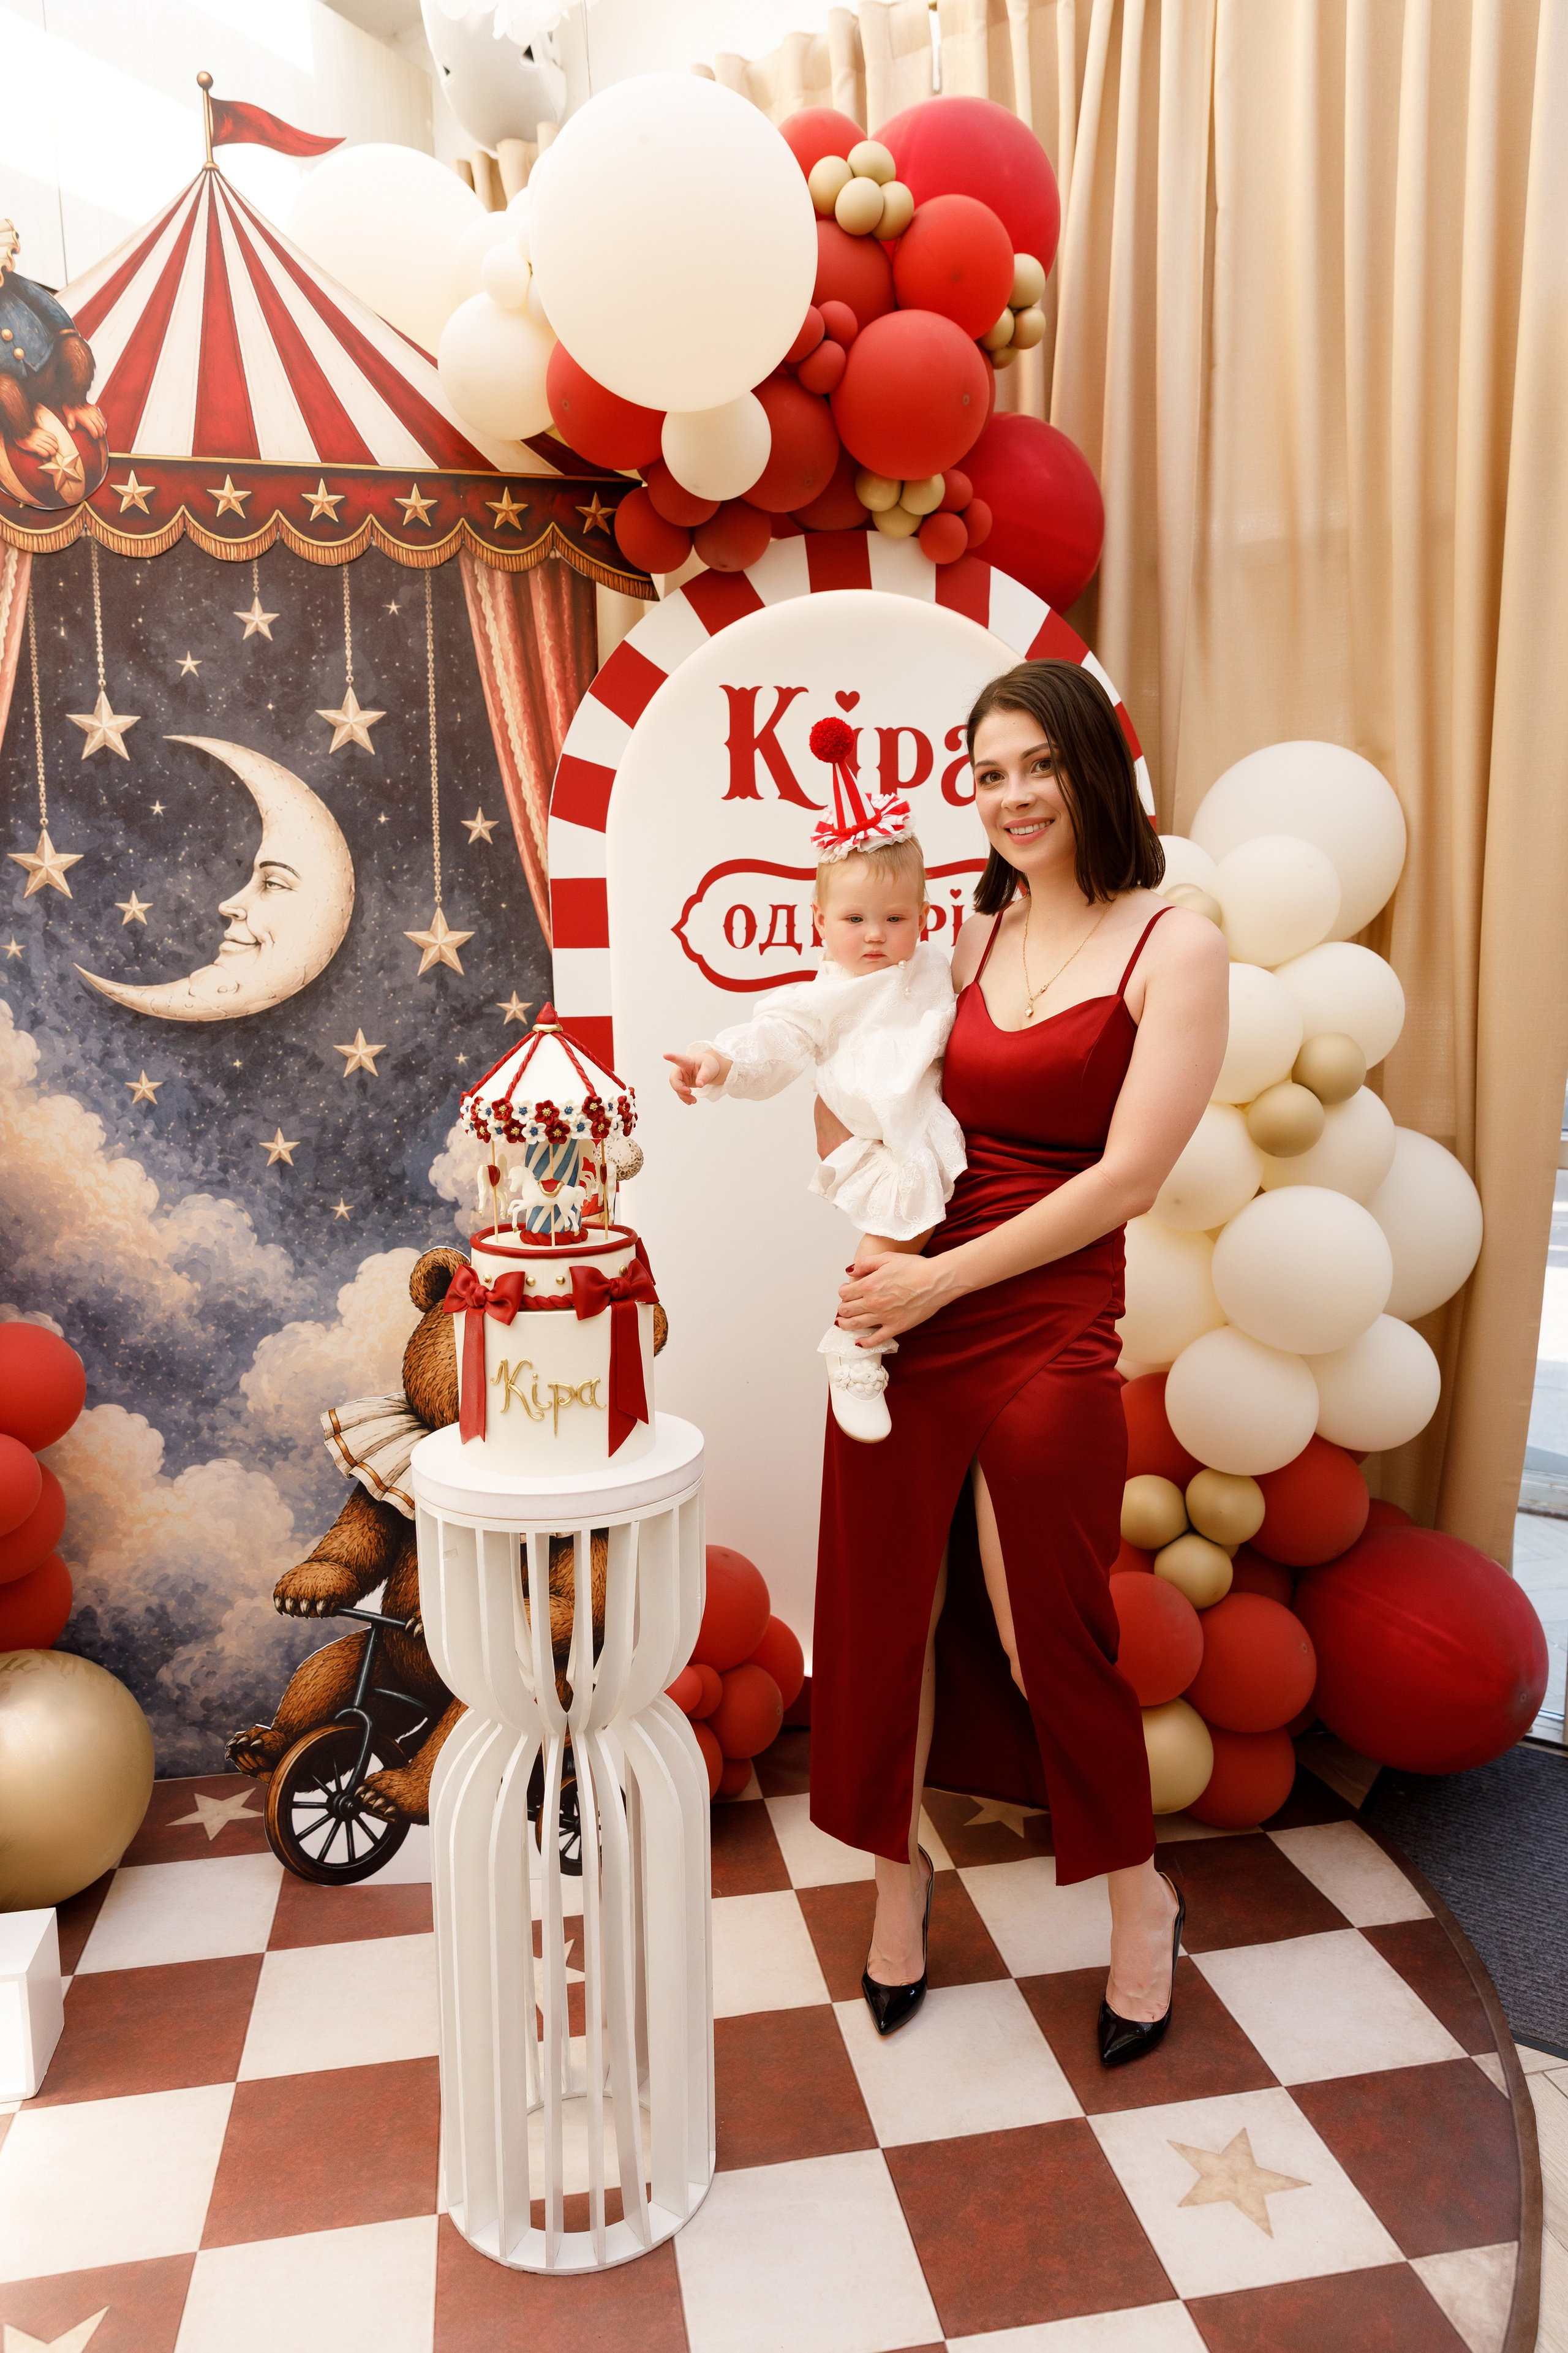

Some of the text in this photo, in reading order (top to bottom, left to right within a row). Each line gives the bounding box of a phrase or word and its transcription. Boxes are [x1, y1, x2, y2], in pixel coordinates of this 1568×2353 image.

[723, 889, 967, 956] од рі
[489, 1358, 607, 1438] Кіра
